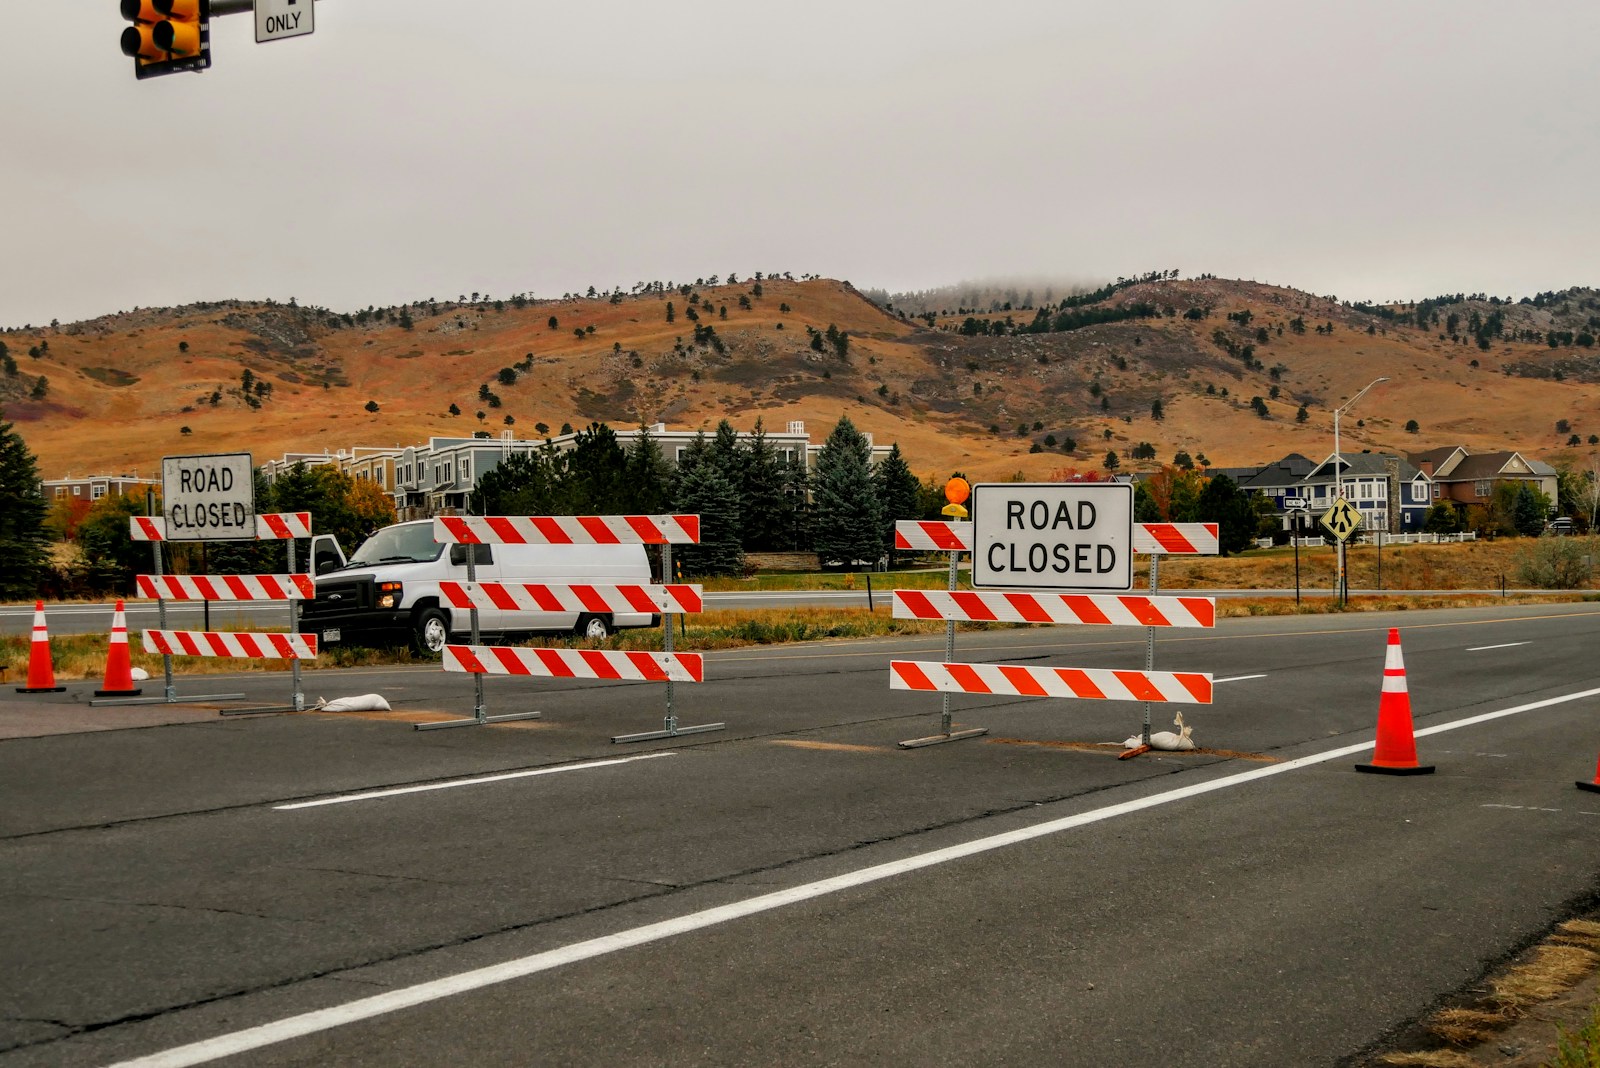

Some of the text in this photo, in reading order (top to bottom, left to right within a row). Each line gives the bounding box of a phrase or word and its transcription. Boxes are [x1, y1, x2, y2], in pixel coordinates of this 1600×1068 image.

[266, 11, 301, 33] ONLY
[181, 467, 233, 493] ROAD
[172, 502, 246, 528] CLOSED
[1006, 500, 1097, 530] ROAD
[987, 542, 1116, 574] CLOSED
